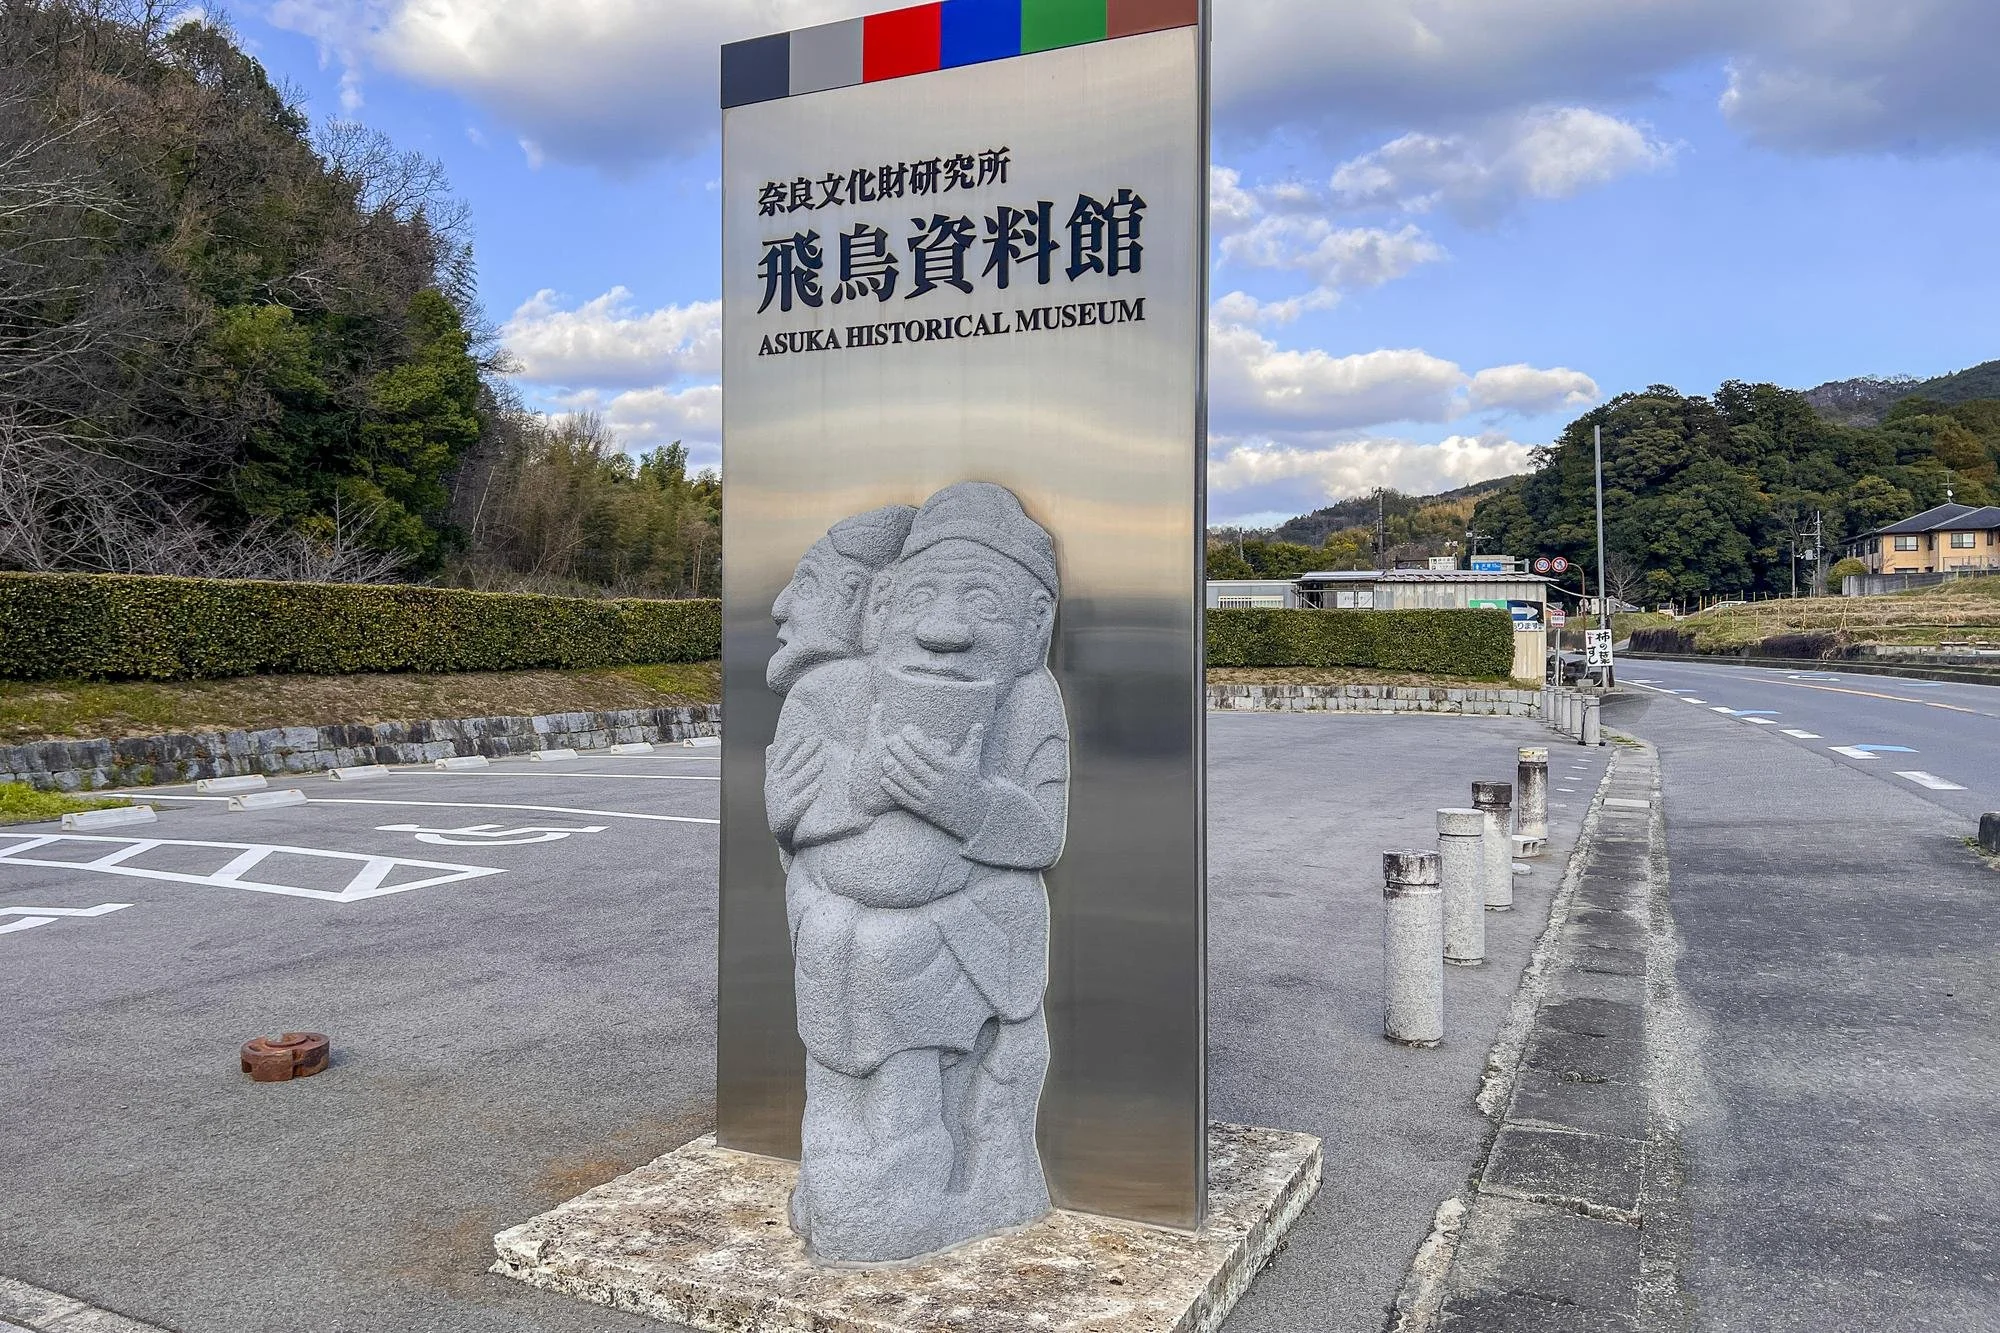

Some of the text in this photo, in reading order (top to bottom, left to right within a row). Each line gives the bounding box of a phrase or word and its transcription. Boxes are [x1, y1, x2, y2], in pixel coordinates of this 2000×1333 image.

[757, 145, 1011, 217] 奈良文化財研究所
[756, 188, 1148, 314] 飛鳥資料館
[758, 297, 1145, 356] ASUKA HISTORICAL MUSEUM
[1539, 561, 1547, 569] 50
